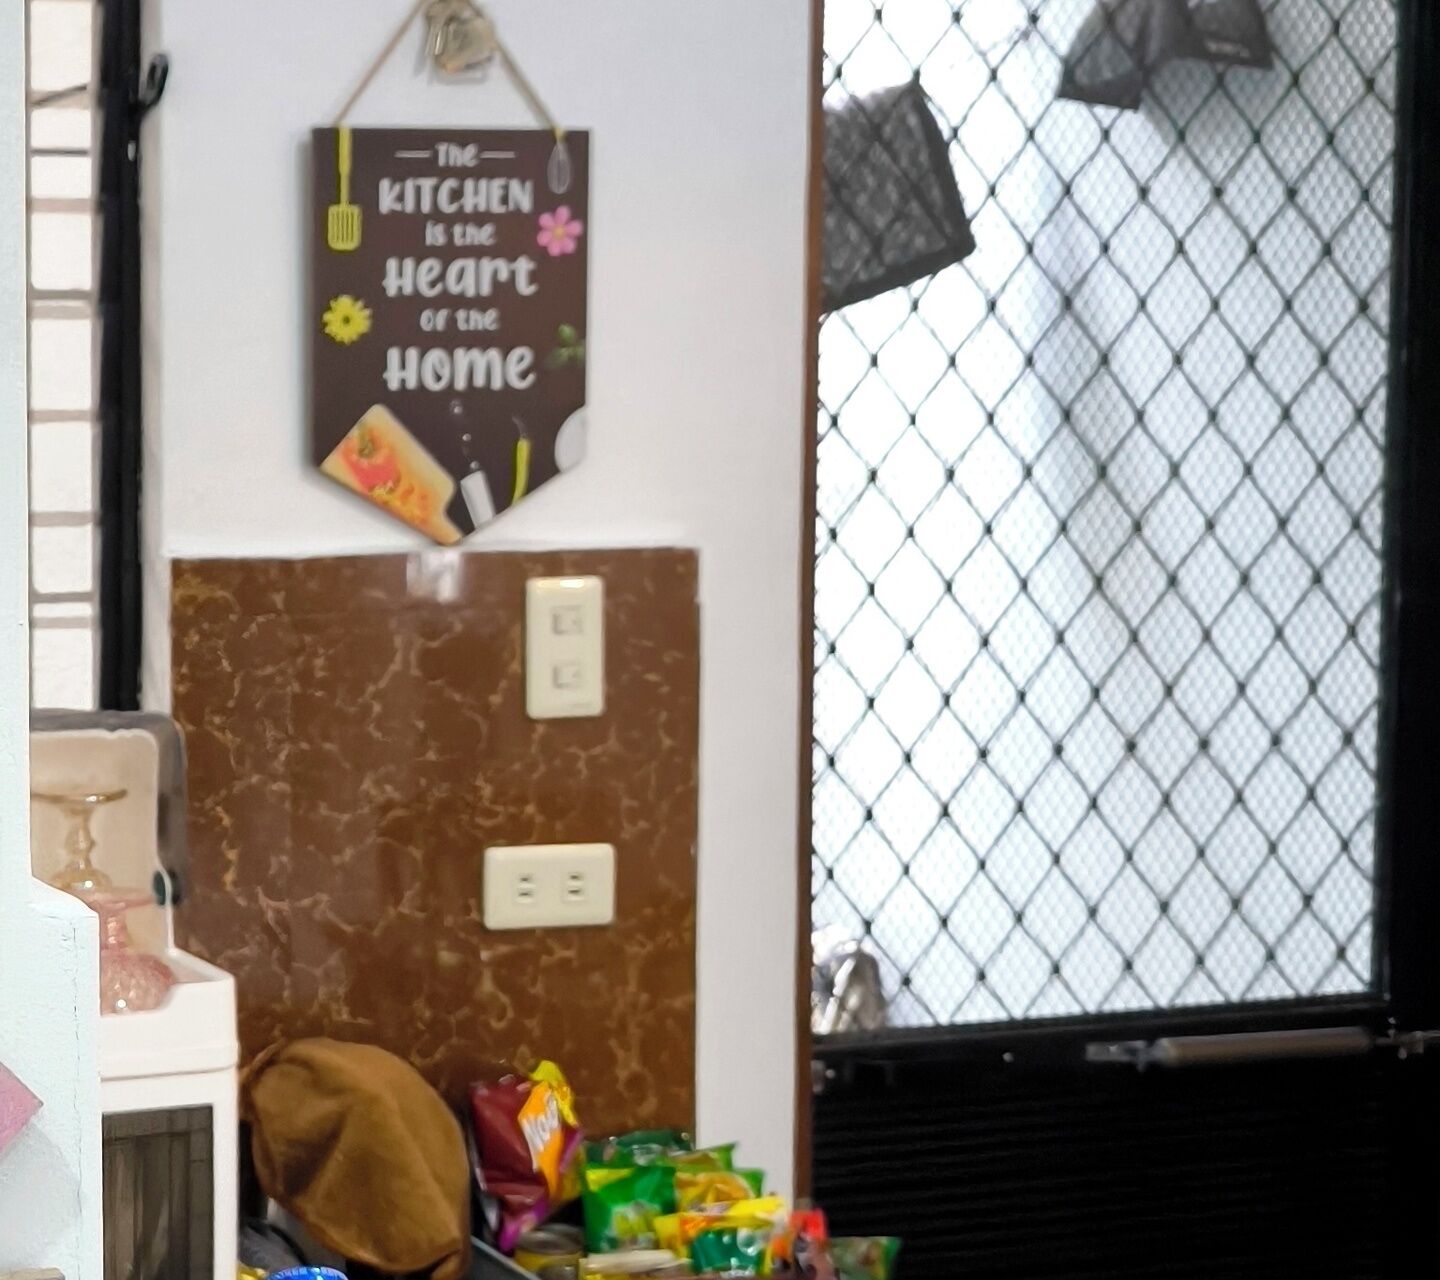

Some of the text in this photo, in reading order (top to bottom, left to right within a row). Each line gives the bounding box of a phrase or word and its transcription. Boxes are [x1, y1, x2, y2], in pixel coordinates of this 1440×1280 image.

[434, 141, 480, 167] The
[378, 177, 535, 214] KITCHEN
[425, 220, 496, 246] is the
[382, 256, 538, 298] Heart
[455, 307, 500, 331] the
